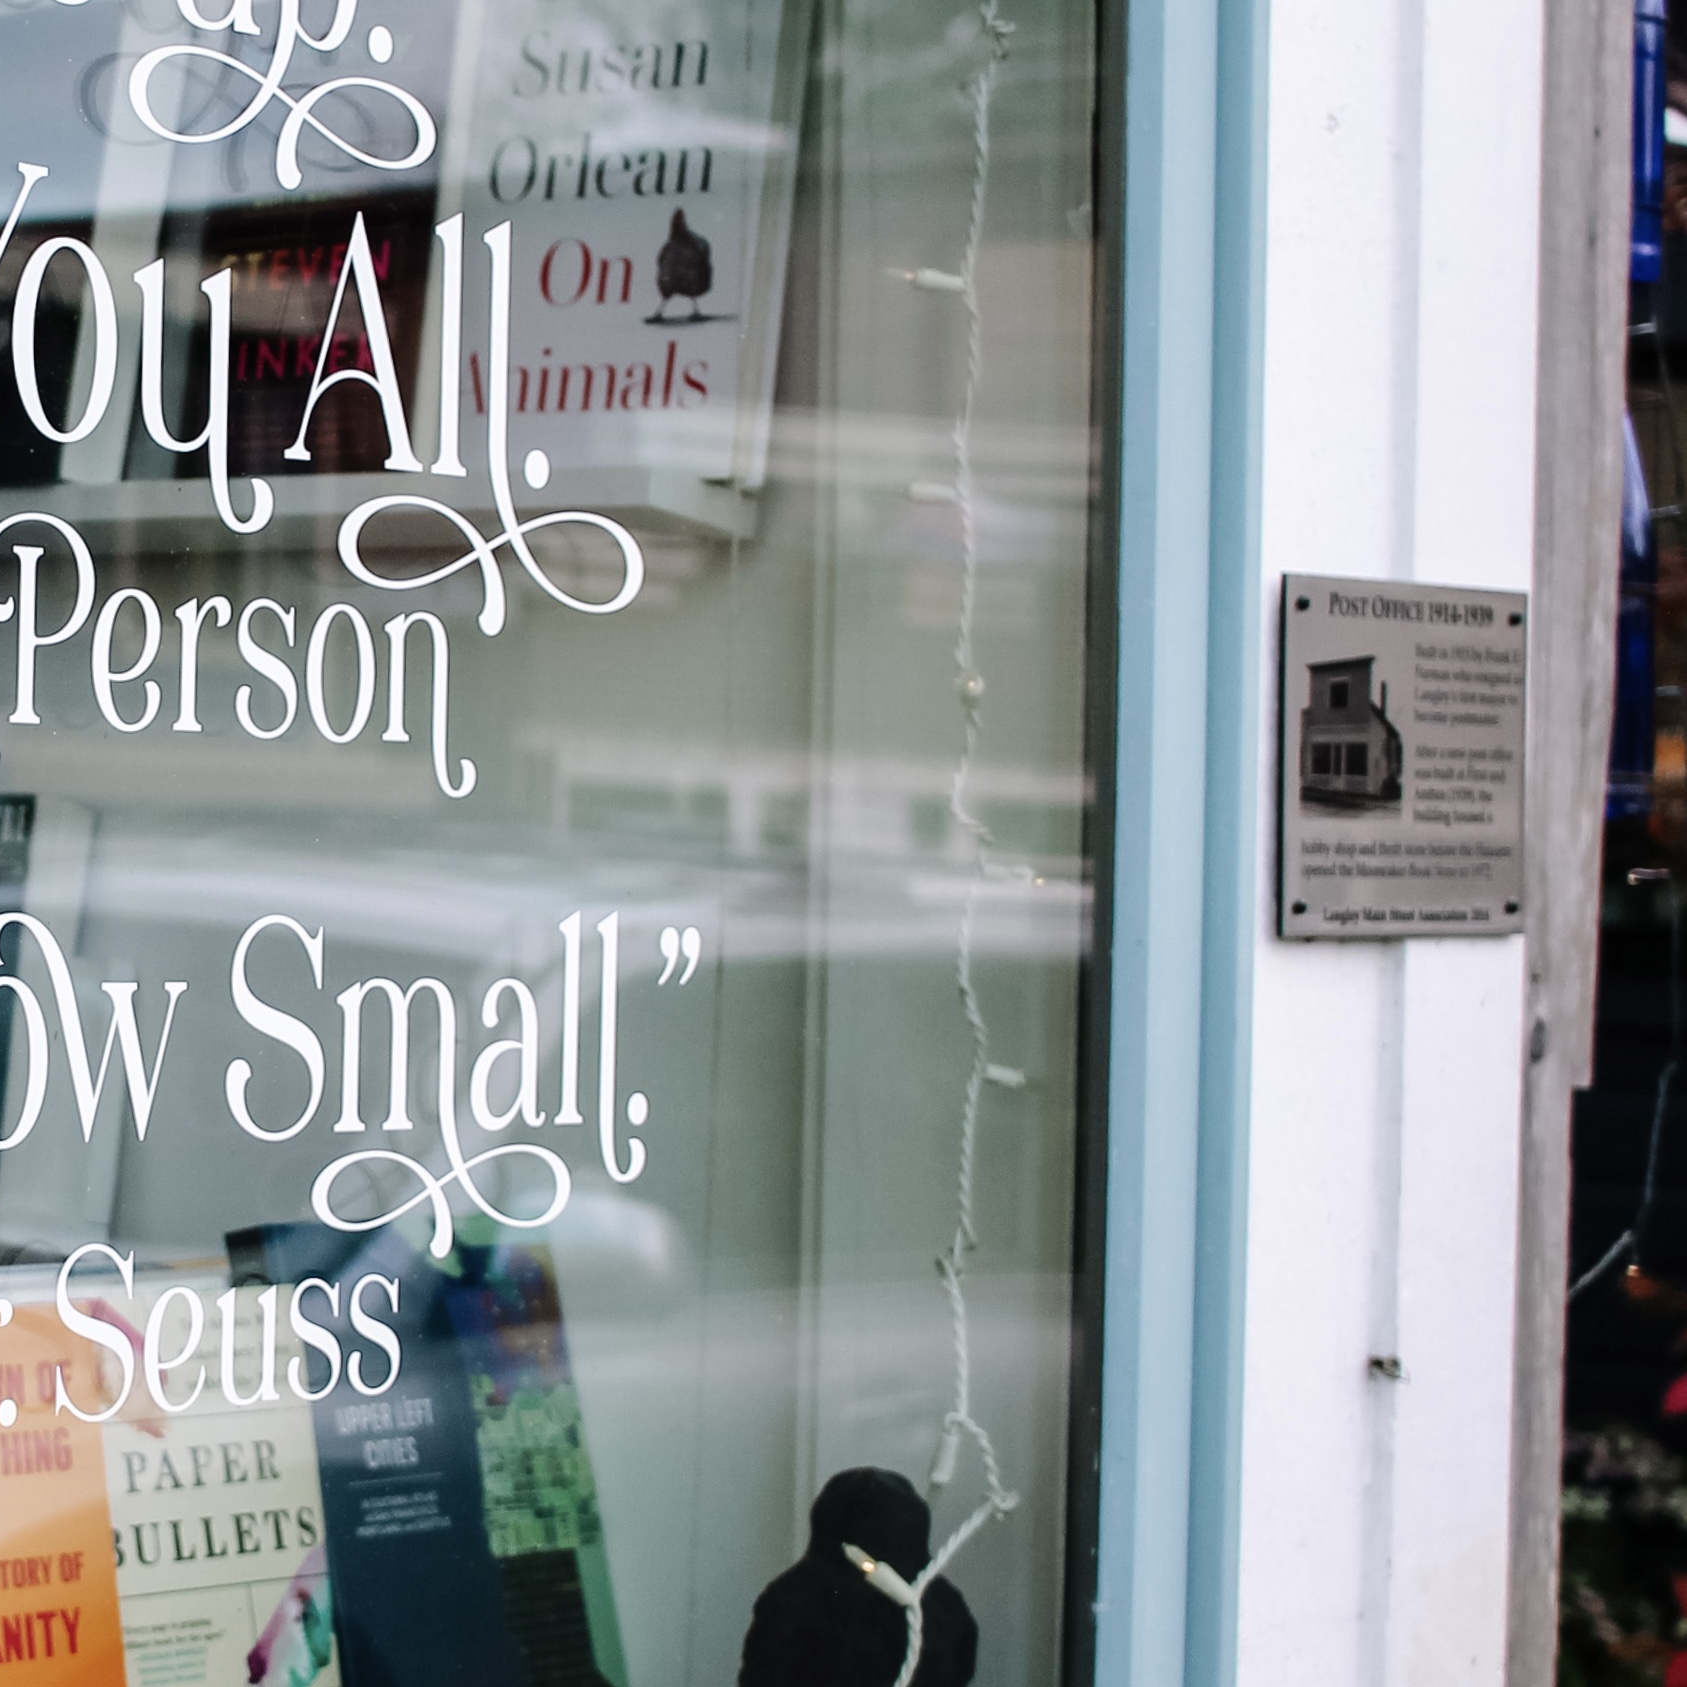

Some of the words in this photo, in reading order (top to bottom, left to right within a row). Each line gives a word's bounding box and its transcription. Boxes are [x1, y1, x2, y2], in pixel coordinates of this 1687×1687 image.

[513, 29, 710, 101] Susan
[489, 131, 714, 206] Orlean
[538, 237, 634, 307] On
[283, 210, 644, 637] All.
[1329, 591, 1369, 617] POST
[1372, 595, 1424, 622] OFFICE
[54, 1242, 401, 1424] Seuss
[122, 1438, 280, 1494] PAPER
[58, 1551, 85, 1584] OF
